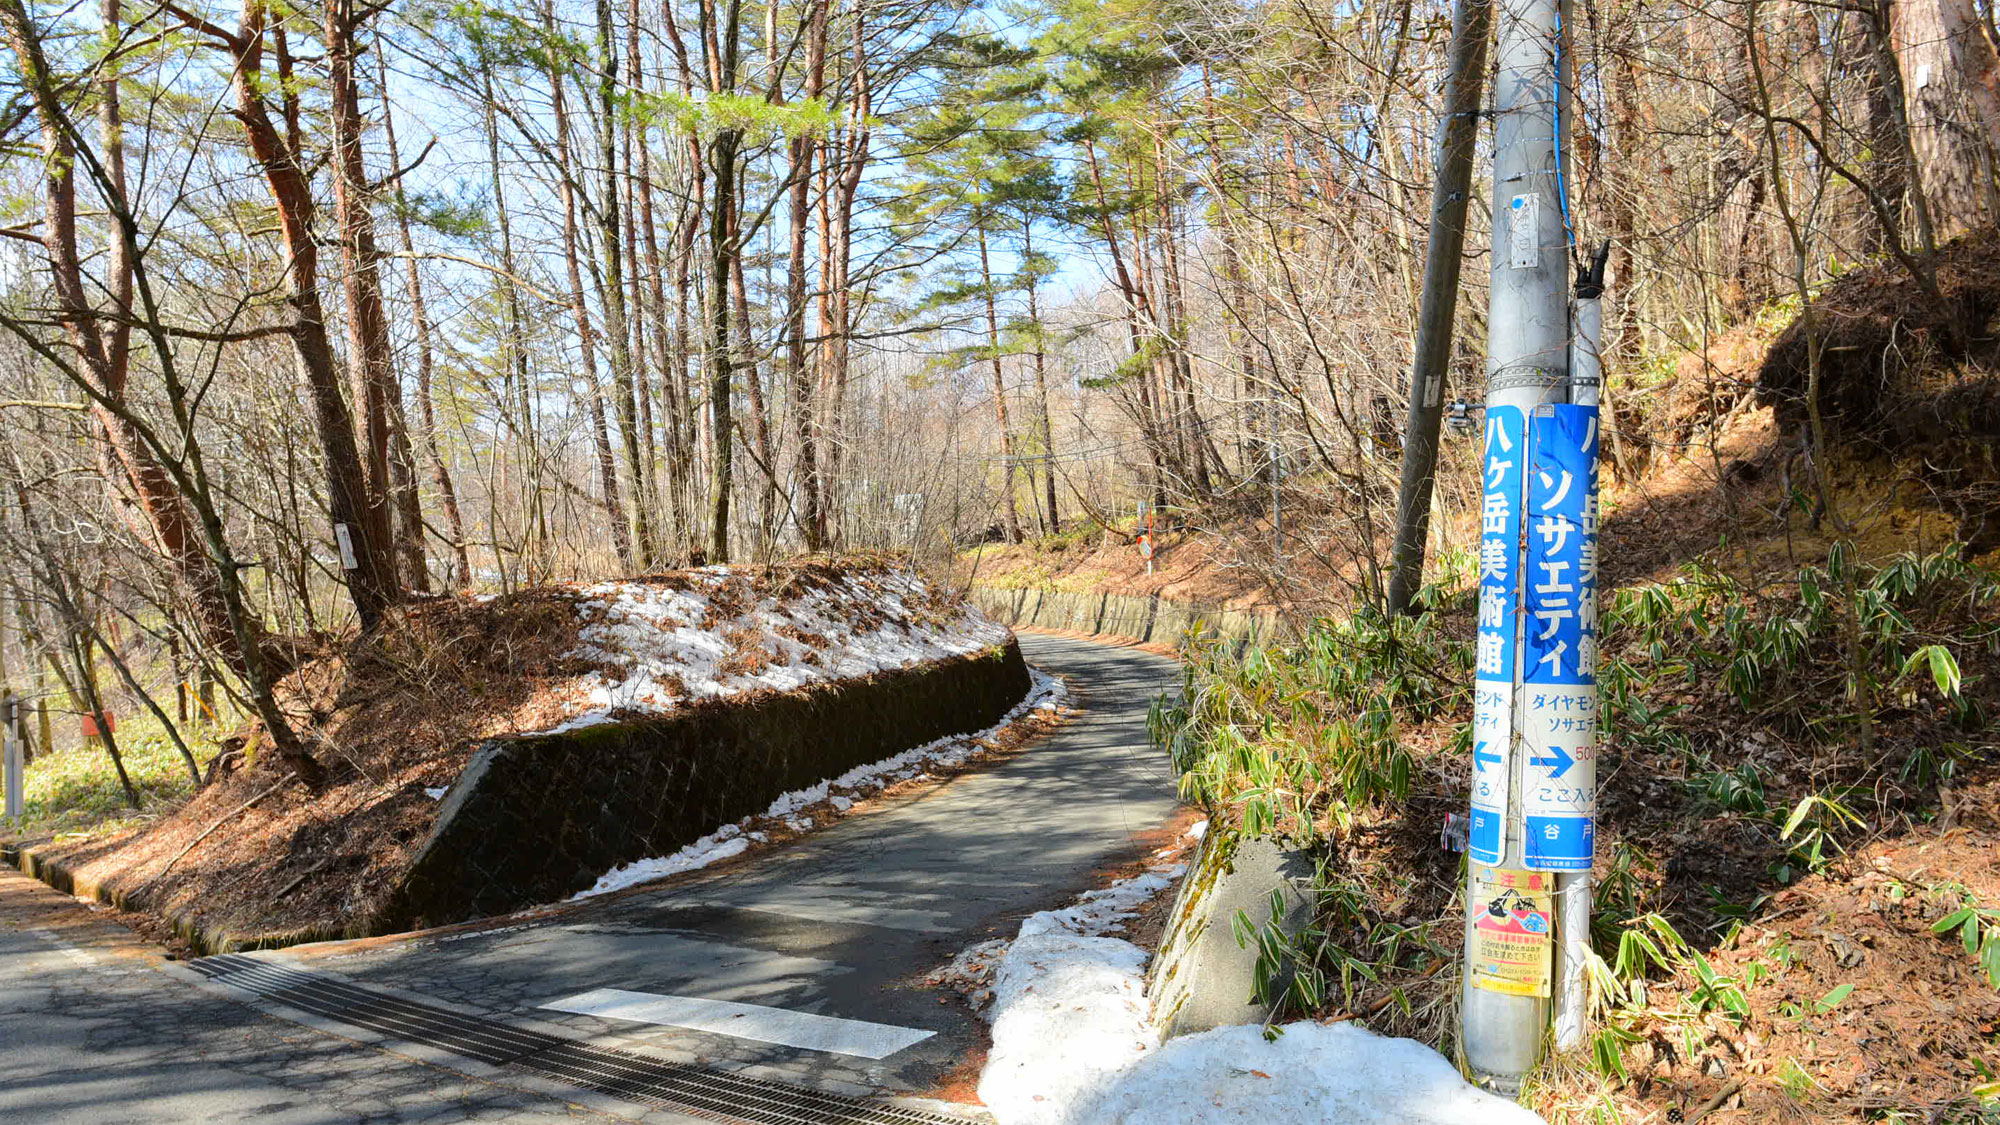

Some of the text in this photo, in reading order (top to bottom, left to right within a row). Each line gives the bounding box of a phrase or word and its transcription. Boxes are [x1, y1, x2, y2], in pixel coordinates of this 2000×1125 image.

[1534, 469, 1576, 678] ソサエティ
